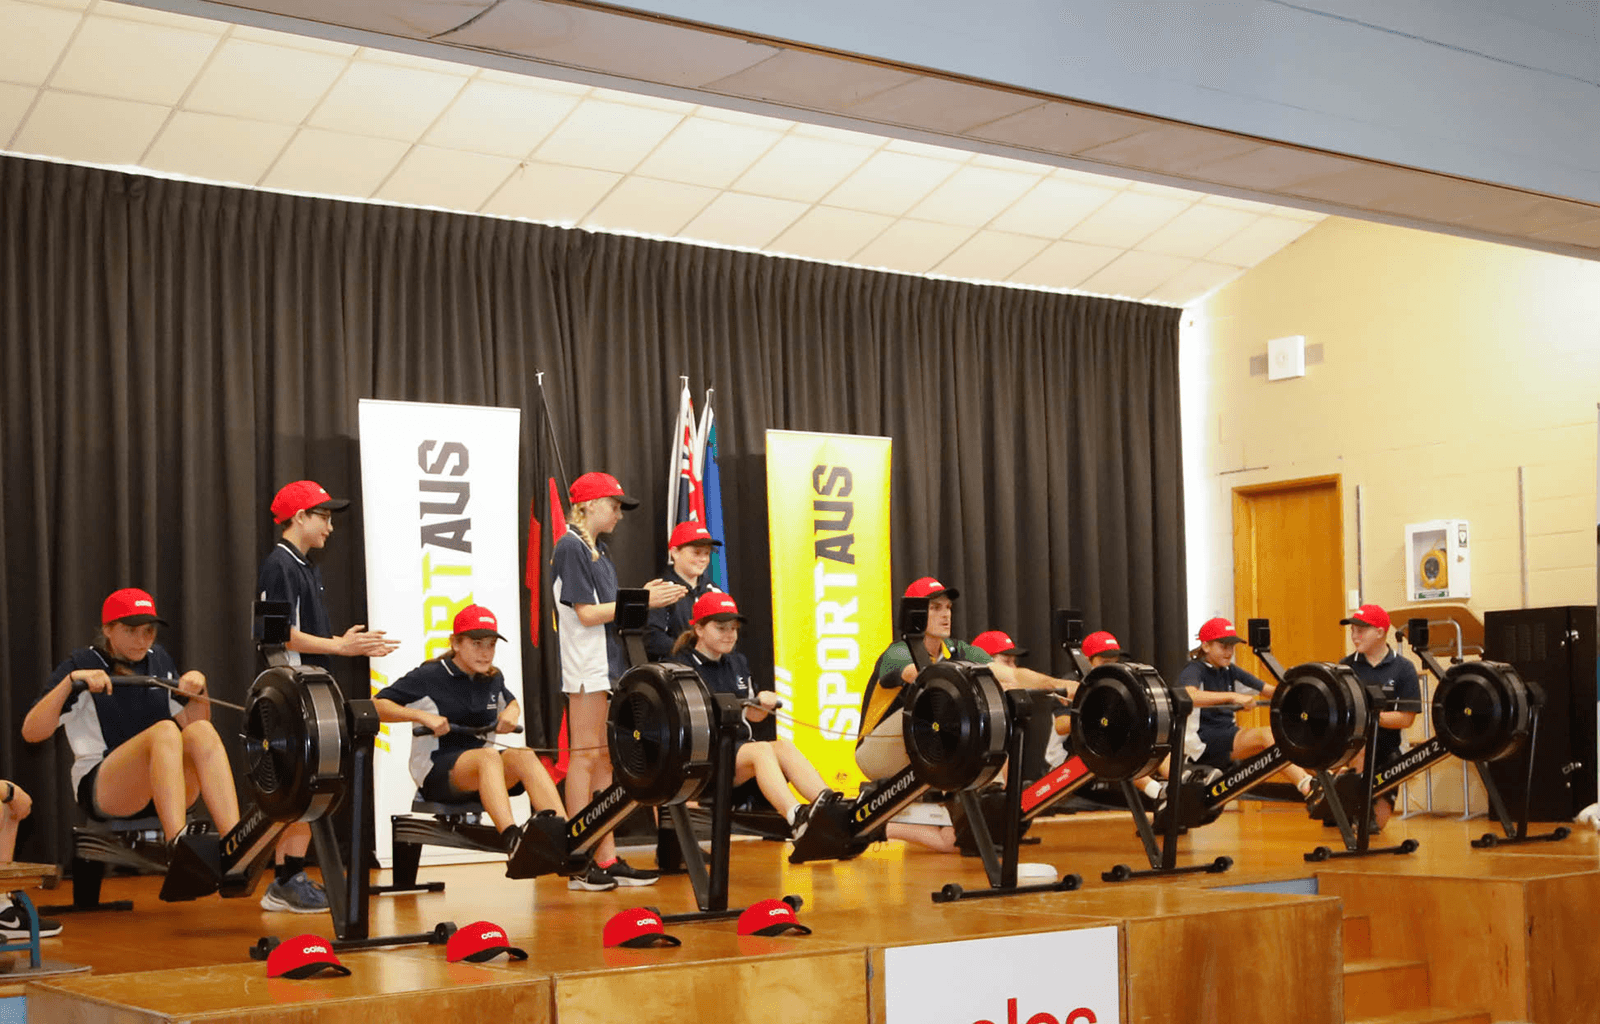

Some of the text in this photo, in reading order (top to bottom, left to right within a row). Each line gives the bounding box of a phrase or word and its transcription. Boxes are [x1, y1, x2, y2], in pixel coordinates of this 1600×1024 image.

[812, 464, 861, 741] SPORTAUS
[1227, 747, 1282, 788] concept 2
[1384, 741, 1440, 780] concept 2
